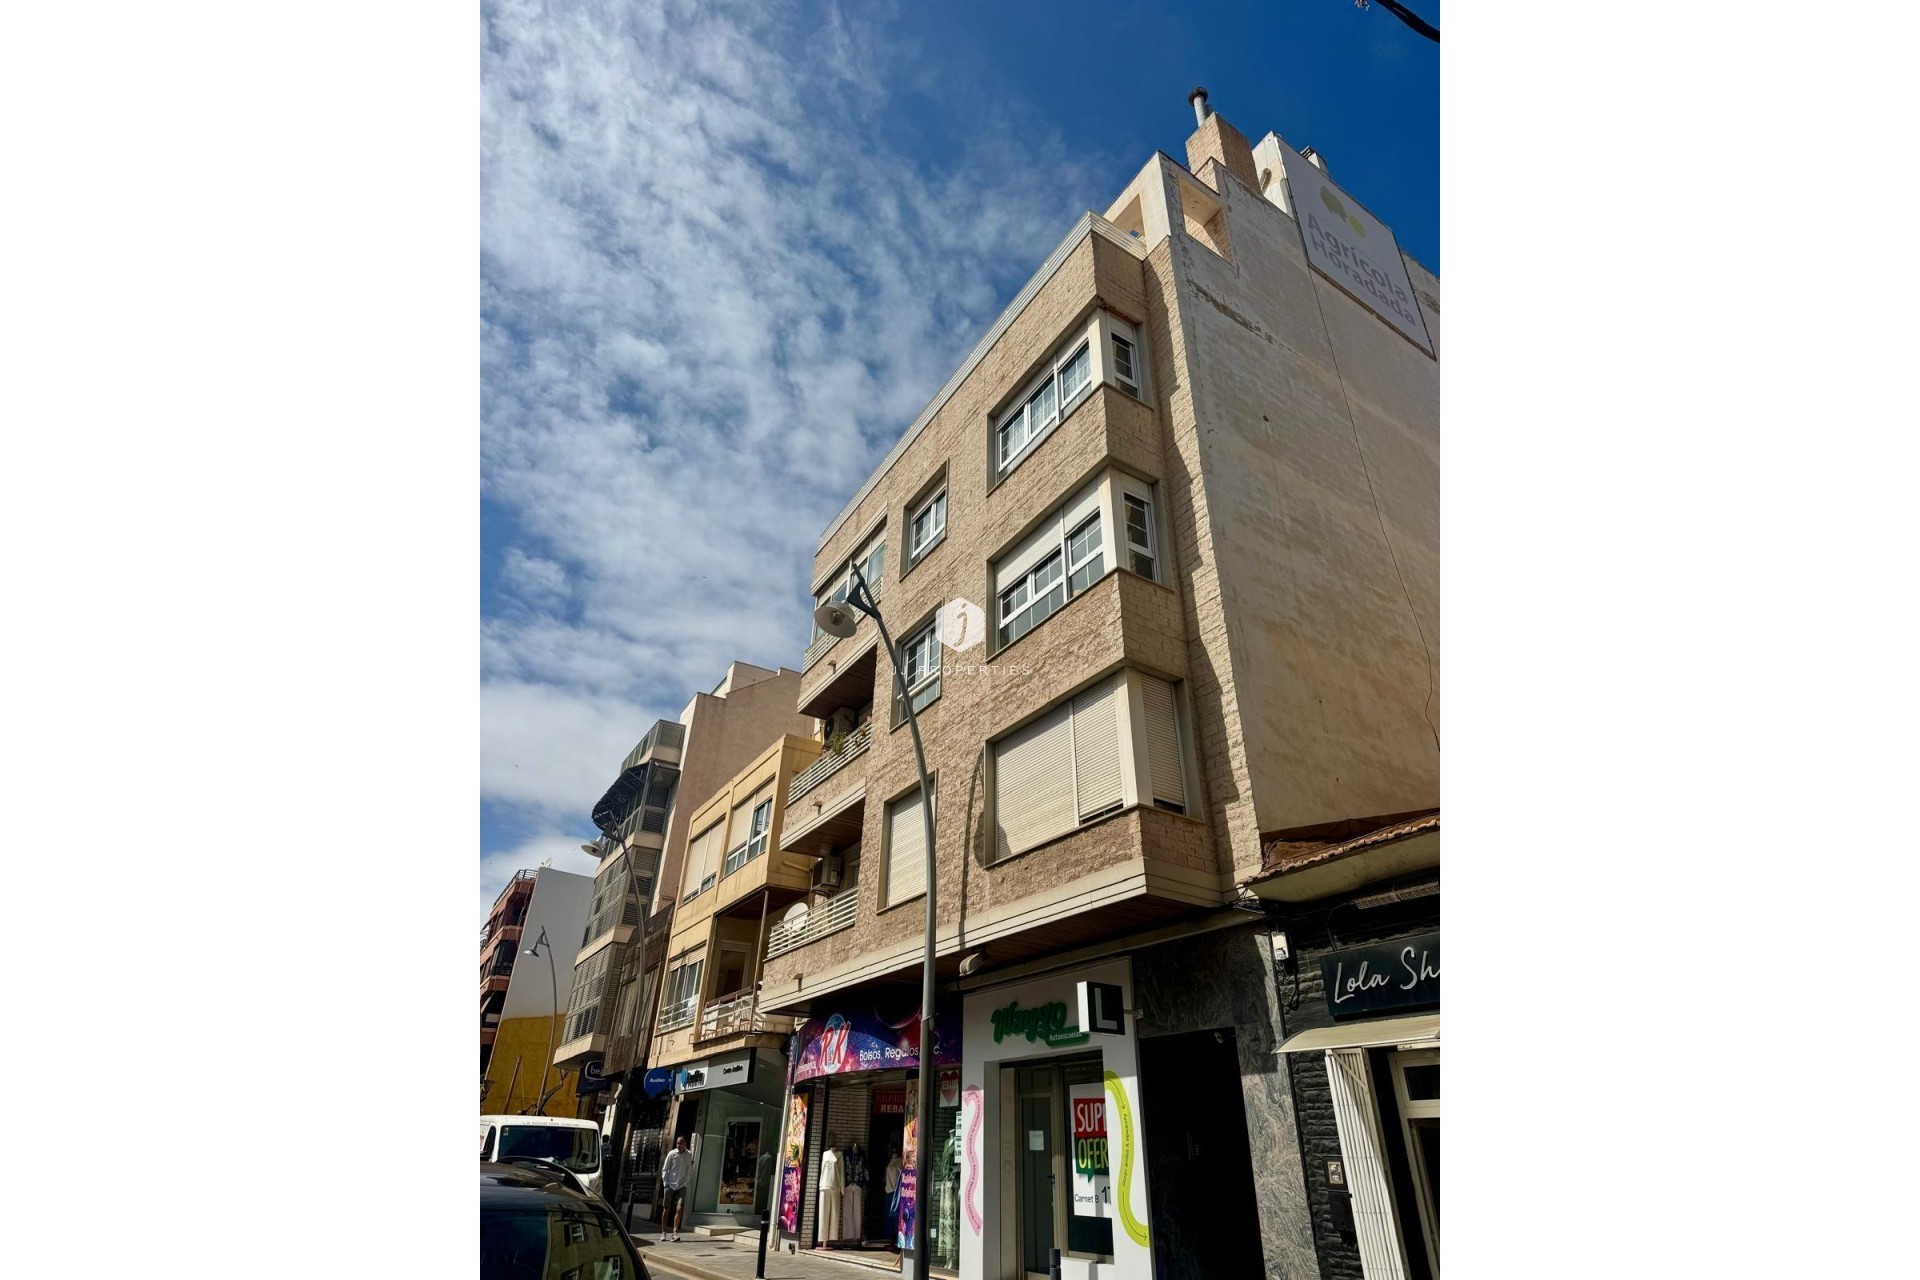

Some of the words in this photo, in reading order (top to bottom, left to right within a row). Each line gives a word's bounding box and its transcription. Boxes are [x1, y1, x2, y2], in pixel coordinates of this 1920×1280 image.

[1310, 232, 1416, 326] Horadada
[1334, 961, 1390, 1004] Lola
[1400, 946, 1440, 990] Sh
[1094, 987, 1118, 1031] L
[1074, 1193, 1094, 1204] Carnet
[1095, 1194, 1100, 1204] B
